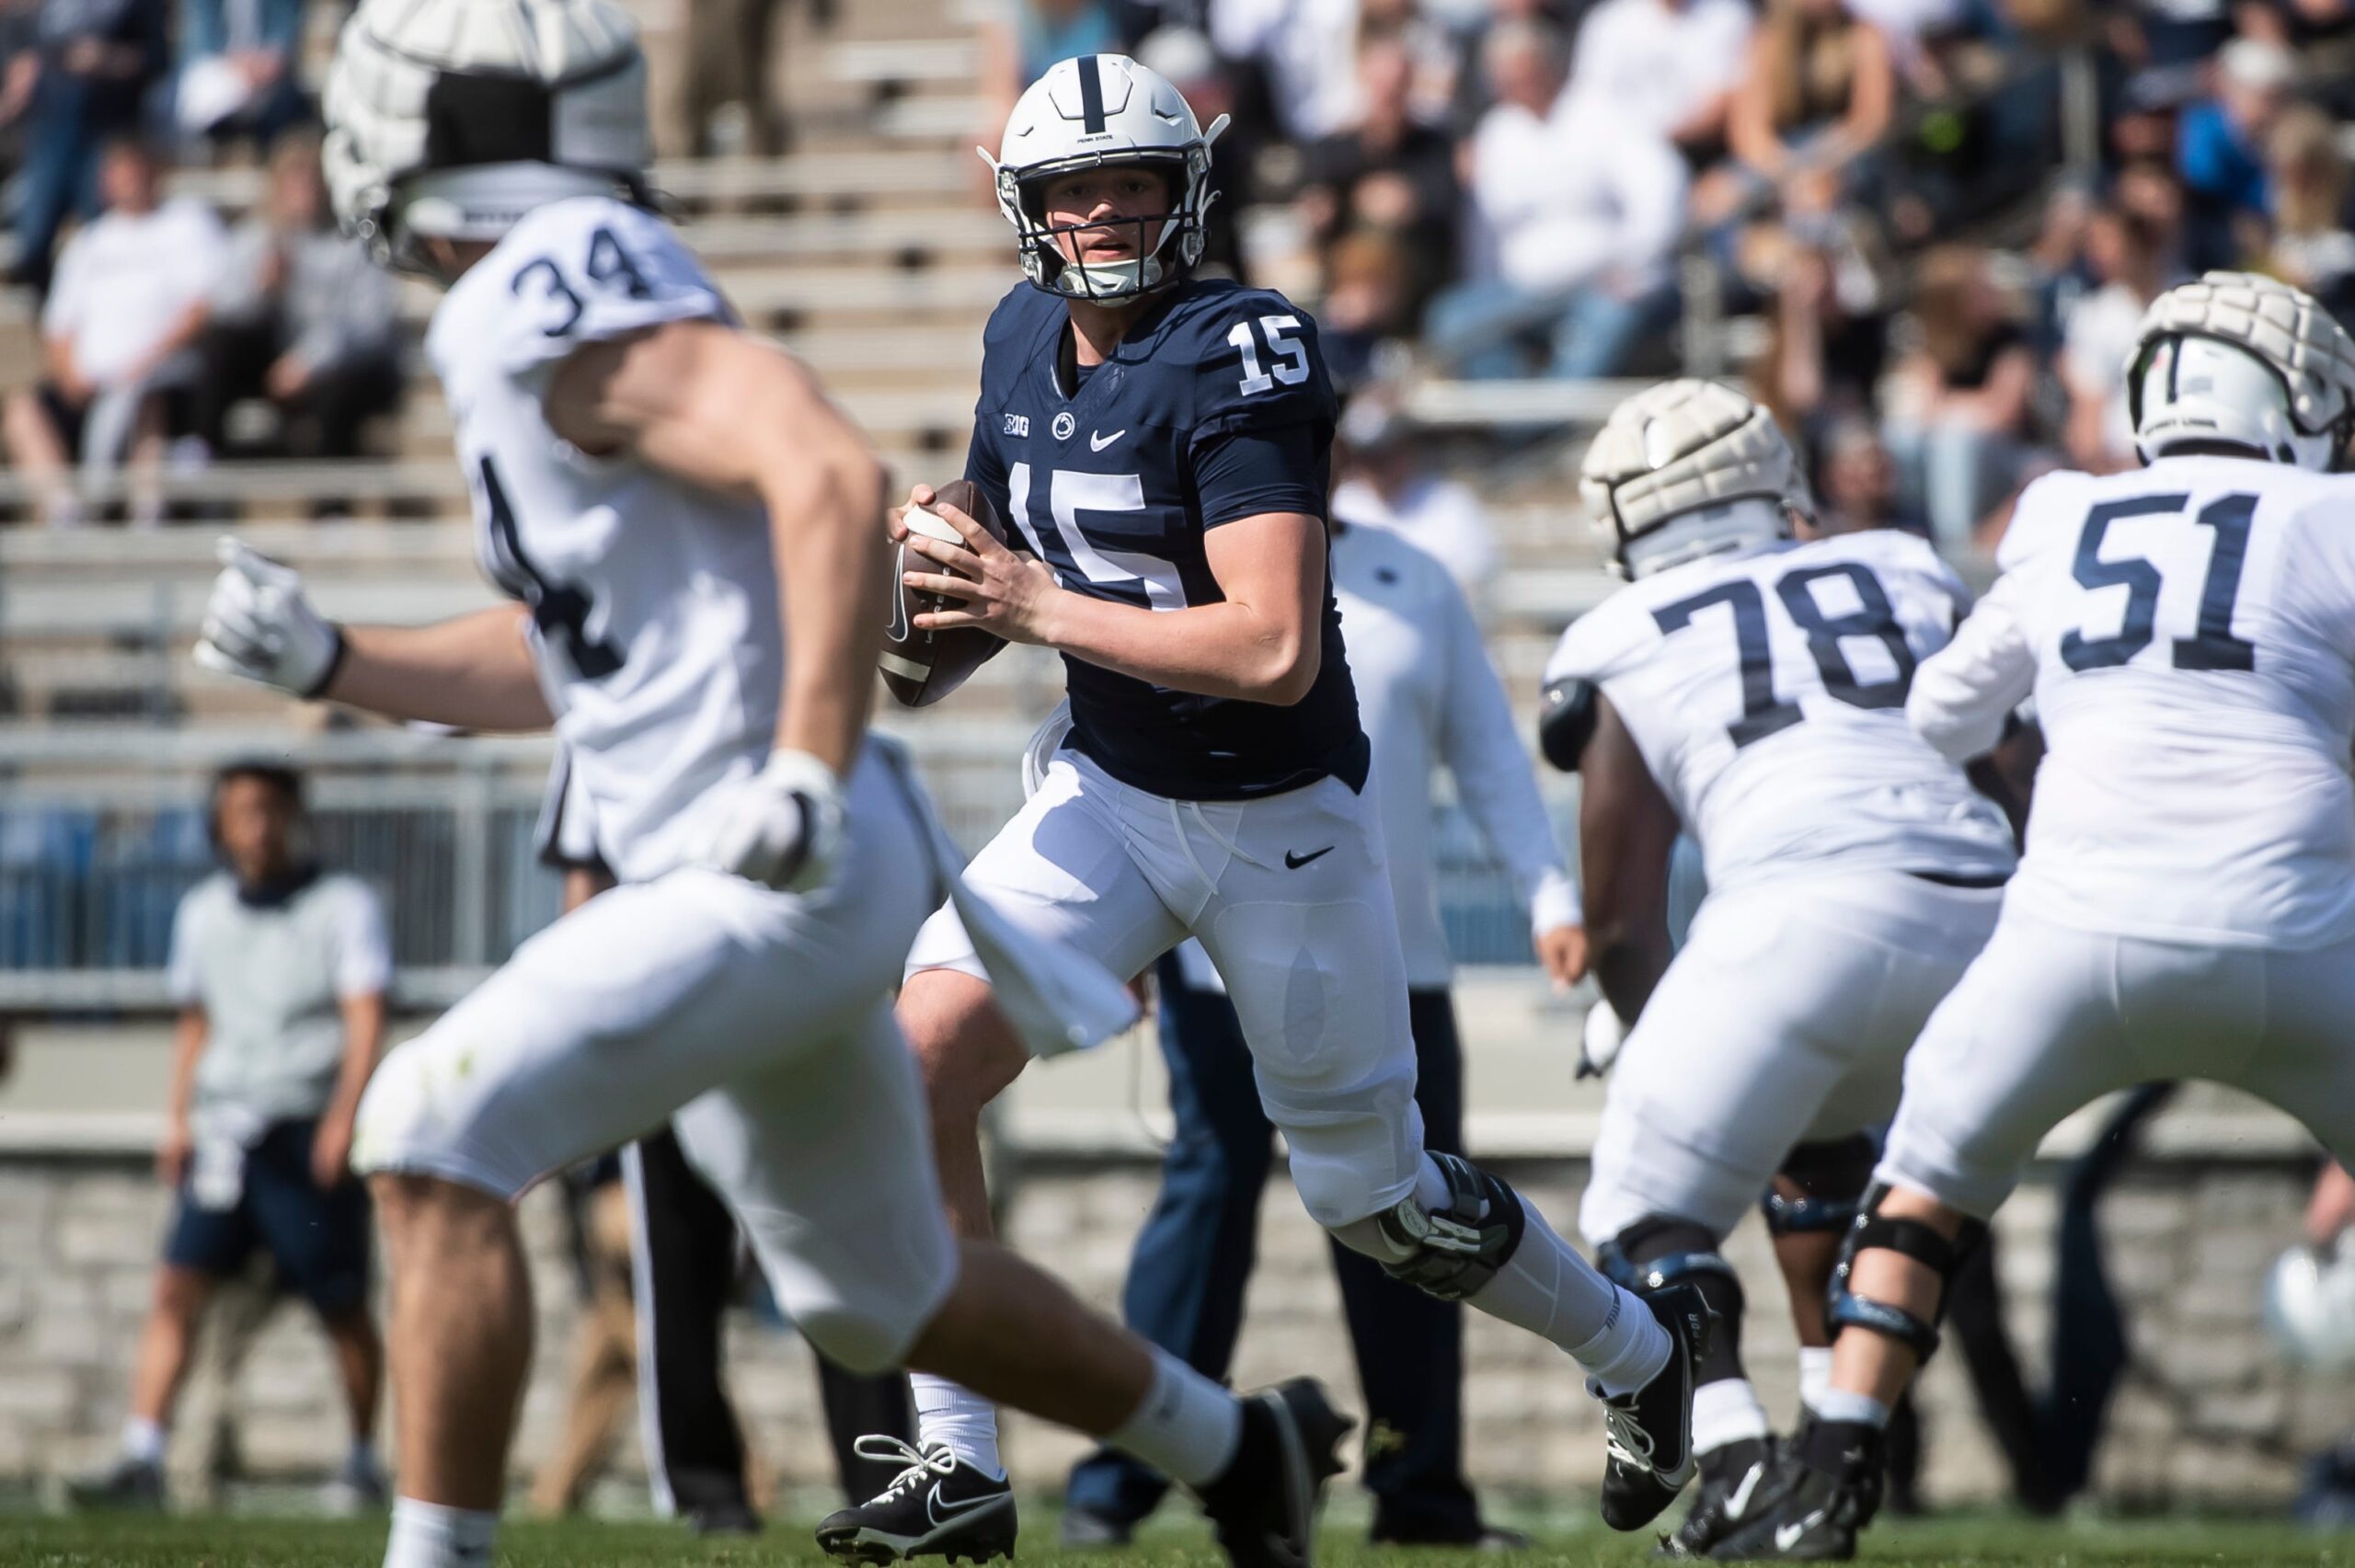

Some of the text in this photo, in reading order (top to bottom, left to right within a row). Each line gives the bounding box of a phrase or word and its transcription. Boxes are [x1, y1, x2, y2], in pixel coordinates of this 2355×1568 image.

[511, 227, 649, 338] 34
[1227, 315, 1310, 396] 15
[1008, 462, 1189, 612] 15
[2061, 492, 2260, 672] 51
[1651, 562, 1919, 748] 78
